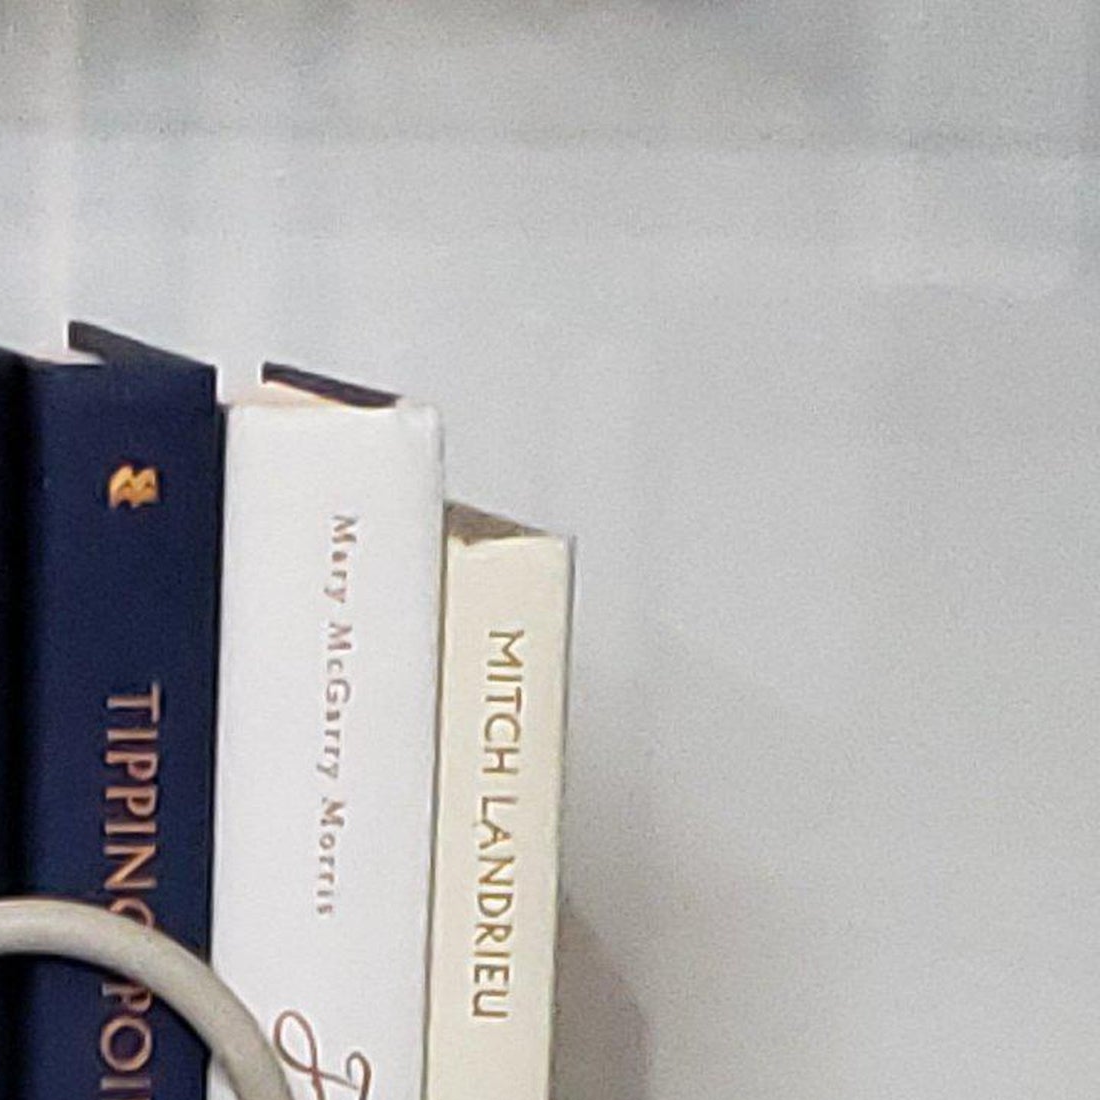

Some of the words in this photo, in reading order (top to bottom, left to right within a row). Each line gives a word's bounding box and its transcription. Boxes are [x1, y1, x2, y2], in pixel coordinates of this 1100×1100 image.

[325, 515, 358, 604] Mary
[317, 623, 353, 779] McGarry
[482, 629, 524, 775] MITCH
[316, 797, 346, 917] Morris
[472, 796, 518, 1019] LANDRIEU
